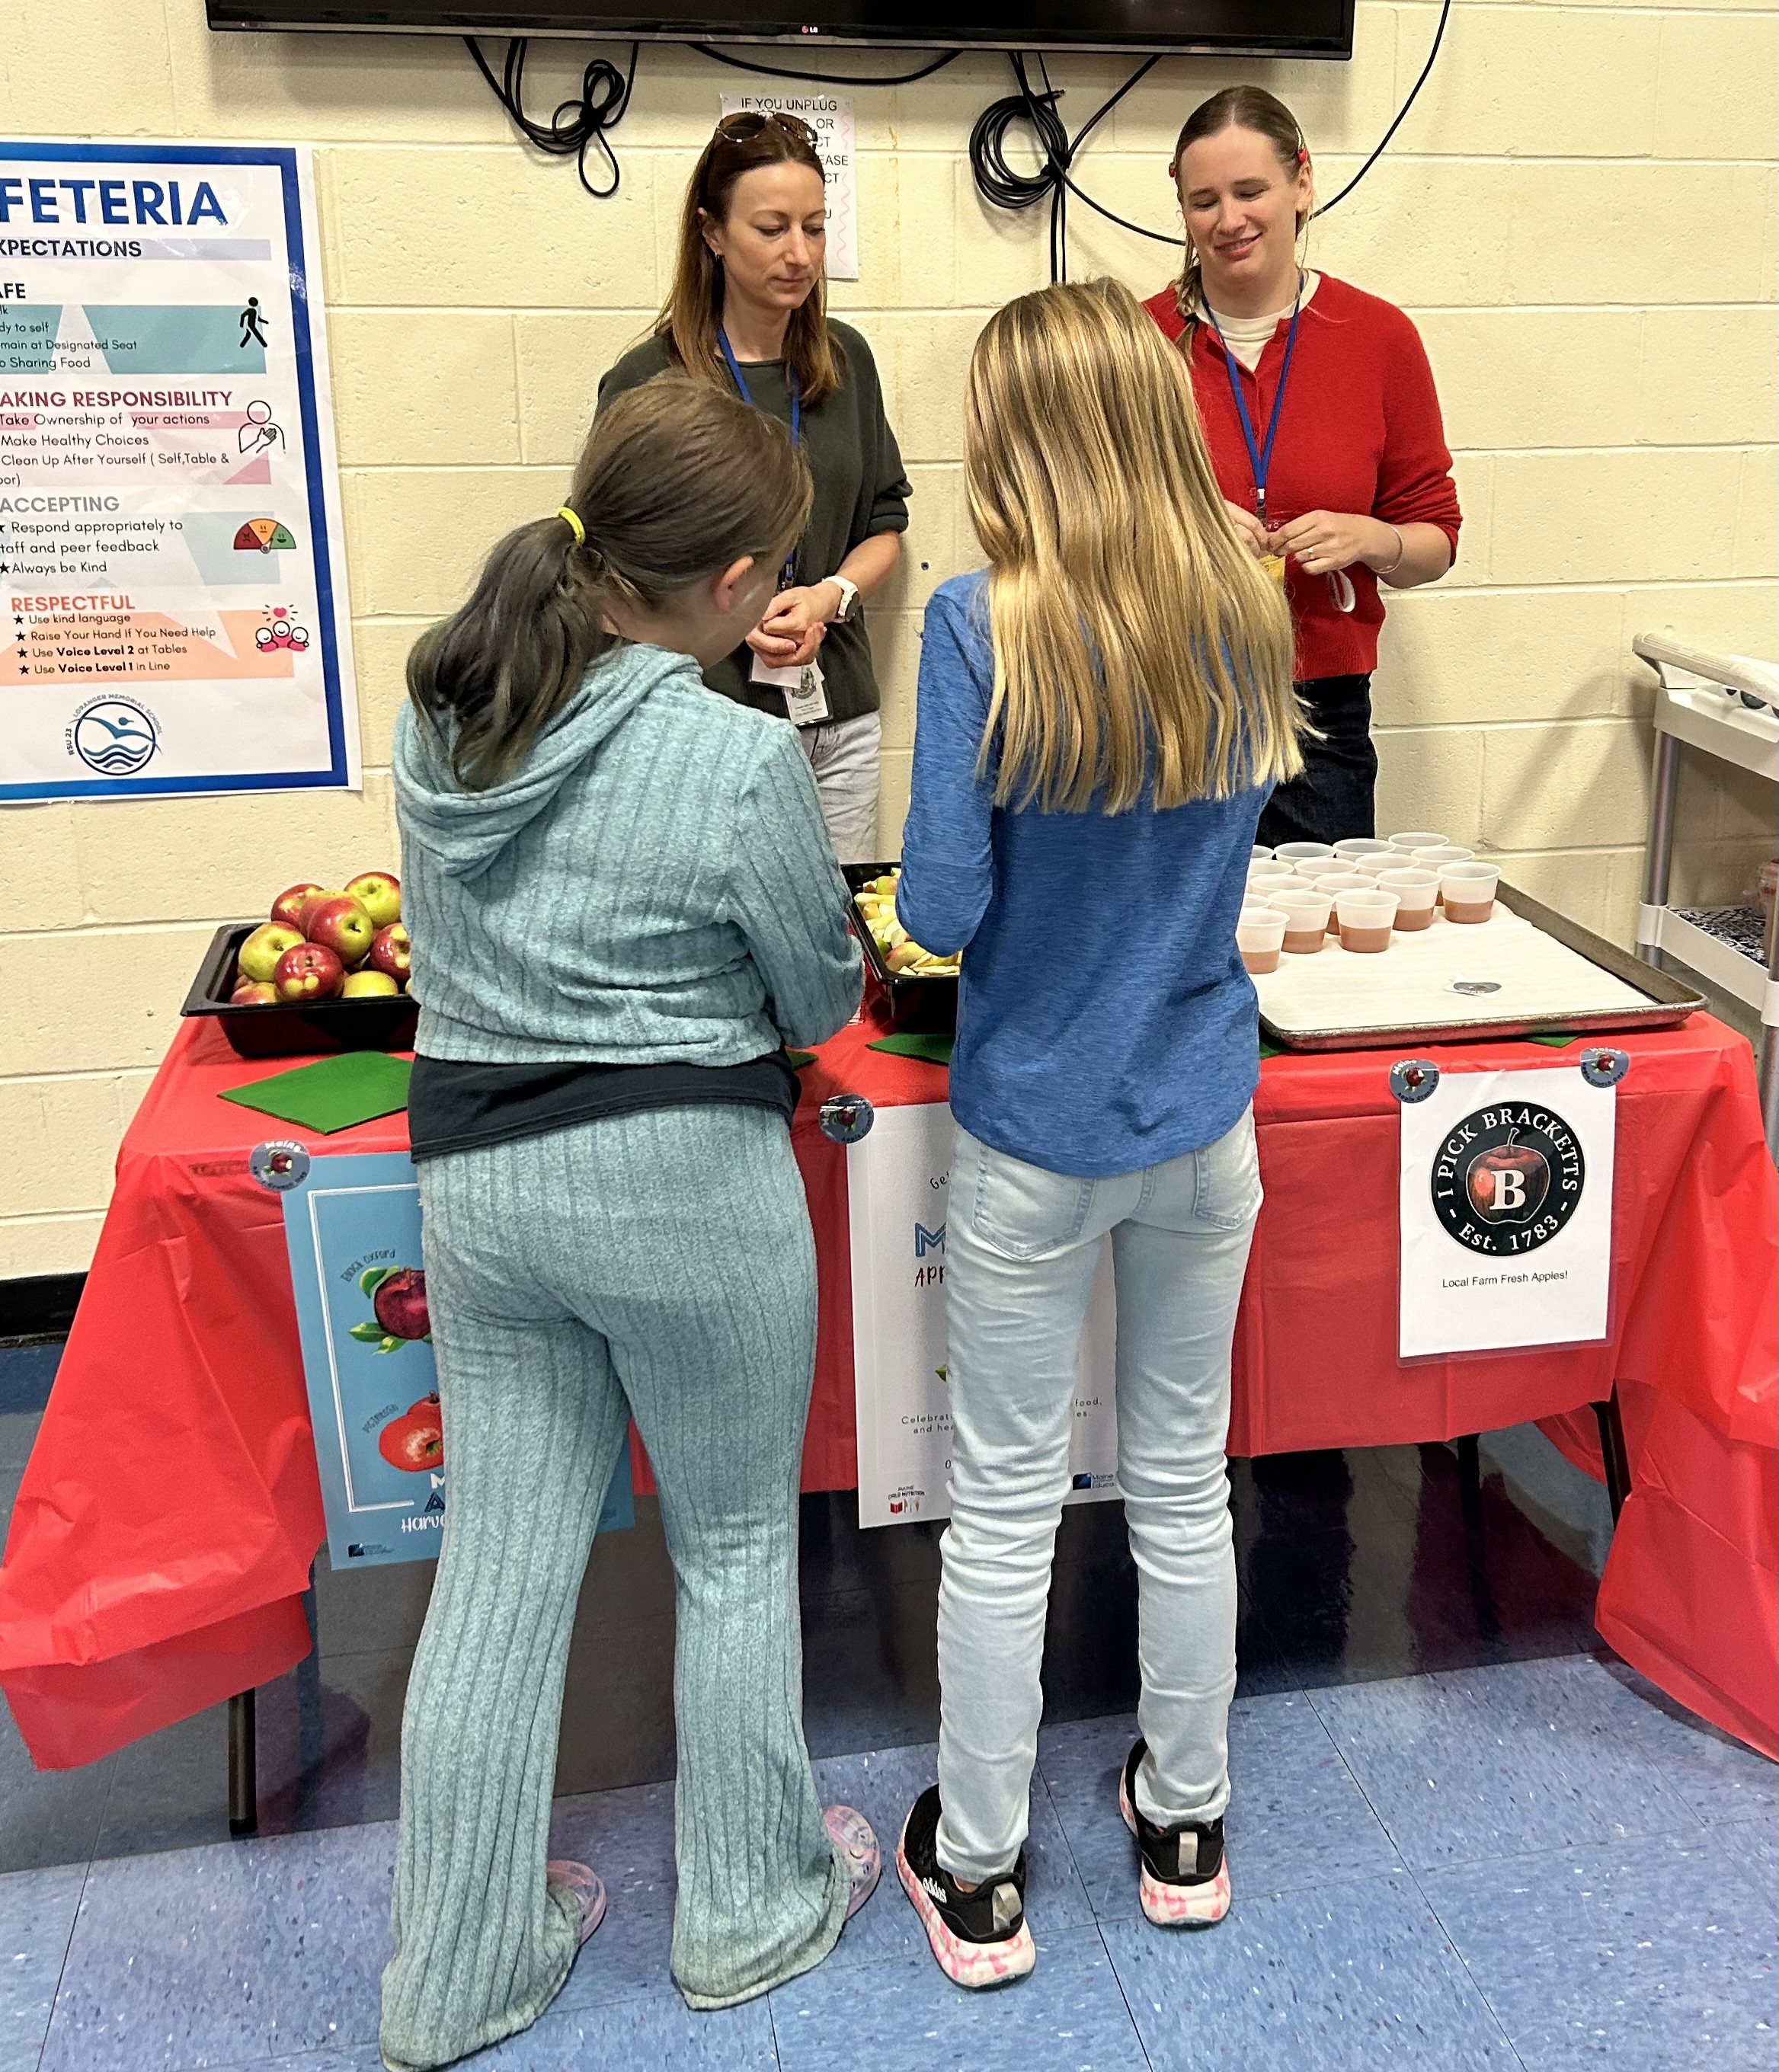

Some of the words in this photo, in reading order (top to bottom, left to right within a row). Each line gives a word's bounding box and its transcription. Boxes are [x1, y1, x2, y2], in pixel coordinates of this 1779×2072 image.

[741, 98, 752, 108] IF
[755, 98, 782, 110] YOU
[786, 98, 837, 111] UNPLUG
[816, 118, 834, 130] OR
[0, 177, 229, 225] FETERIA
[0, 282, 27, 299] FE
[15, 323, 26, 332] to
[30, 321, 50, 332] self
[1, 340, 27, 350] main
[31, 341, 42, 350] at
[46, 339, 109, 352] Designated
[112, 339, 137, 350] Seat
[10, 356, 56, 371] Sharing
[60, 357, 91, 368] Food
[0, 392, 66, 407] AKING
[73, 391, 232, 407] RESPONSIBILITY
[0, 413, 30, 425] Take
[34, 413, 105, 428] Ownership
[110, 413, 123, 425] of
[132, 416, 158, 427] your
[163, 414, 210, 425] actions
[2, 434, 37, 446] Make
[42, 433, 91, 449] Healthy
[95, 433, 149, 446] Choices
[2, 454, 38, 466] Clean
[42, 455, 59, 468] Up
[63, 455, 93, 465] After
[98, 452, 146, 465] Yourself
[221, 453, 229, 464] &
[0, 496, 120, 513] ACCEPTING
[11, 520, 70, 536] Respond
[75, 518, 165, 535] appropriately
[169, 520, 184, 530] to
[0, 540, 25, 554] taff
[30, 540, 56, 553] and
[61, 543, 91, 556] peer
[96, 539, 160, 552] feedback
[12, 561, 56, 576] Always
[60, 561, 76, 573] be
[80, 560, 107, 572] Kind
[11, 594, 136, 612] RESPECTFUL
[29, 615, 50, 625] Use
[53, 612, 75, 623] kind
[78, 613, 131, 625] language
[31, 631, 61, 641] Raise
[63, 630, 90, 641] Your
[93, 629, 122, 640] Hand
[124, 629, 132, 638] If
[135, 628, 157, 638] You
[159, 627, 188, 638] Need
[191, 626, 216, 639] Help
[32, 648, 53, 658] Use
[56, 647, 91, 657] Voice
[94, 645, 125, 656] Level
[127, 645, 135, 655] 2
[137, 646, 149, 655] at
[152, 644, 187, 655] Tables
[34, 664, 55, 674] Use
[58, 663, 93, 673] Voice
[95, 661, 126, 672] Level
[129, 662, 133, 672] 1
[136, 661, 146, 671] in
[149, 660, 171, 671] Line
[72, 694, 107, 718] LORANGER
[108, 693, 145, 711] MEMORIAL
[145, 708, 162, 735] SCHOOL
[1437, 1124, 1478, 1179] PICK
[1481, 1108, 1579, 1191] BRACKETTS
[1438, 1188, 1454, 1198] I
[1489, 1169, 1526, 1210] B
[1458, 1223, 1497, 1251] Est.
[1509, 1215, 1559, 1251] 1783
[1442, 1277, 1469, 1288] Local
[1472, 1275, 1498, 1286] Farm
[1501, 1273, 1528, 1284] Fresh
[1531, 1270, 1568, 1283] Apples!
[913, 1424, 933, 1434] and
